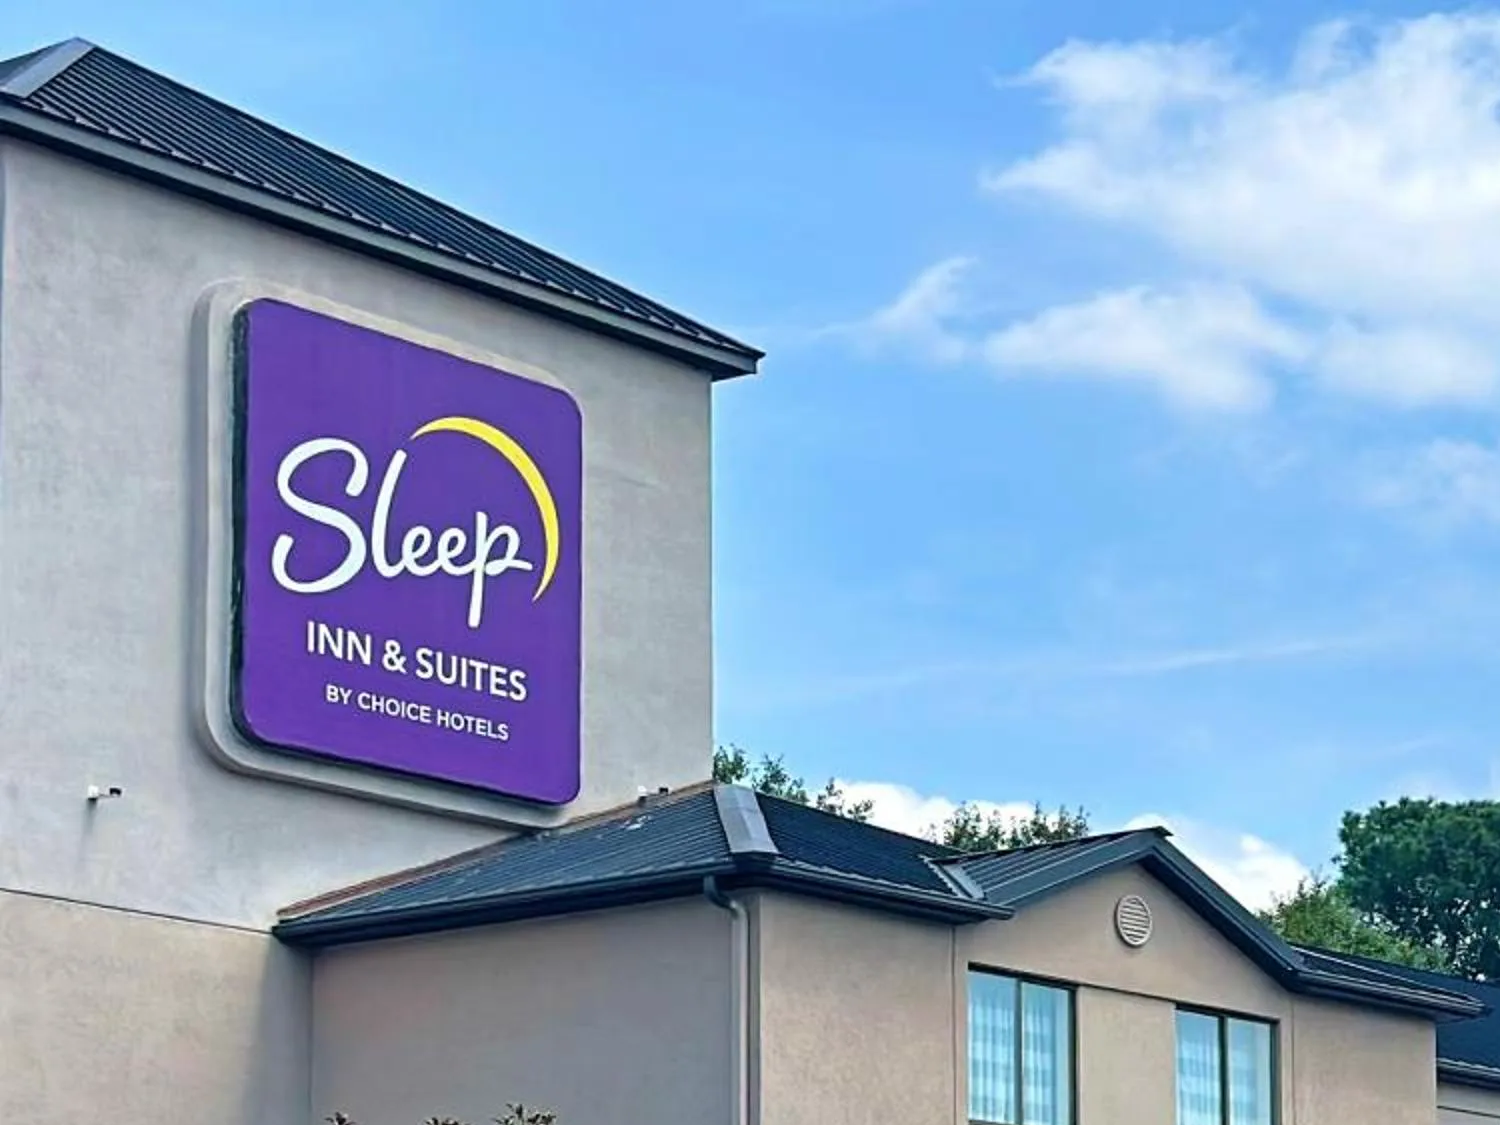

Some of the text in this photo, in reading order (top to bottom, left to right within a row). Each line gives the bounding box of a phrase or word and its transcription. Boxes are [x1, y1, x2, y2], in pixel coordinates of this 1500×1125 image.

[271, 437, 534, 629] Sleep
[306, 620, 528, 702] INN & SUITES
[325, 683, 510, 742] BY CHOICE HOTELS
